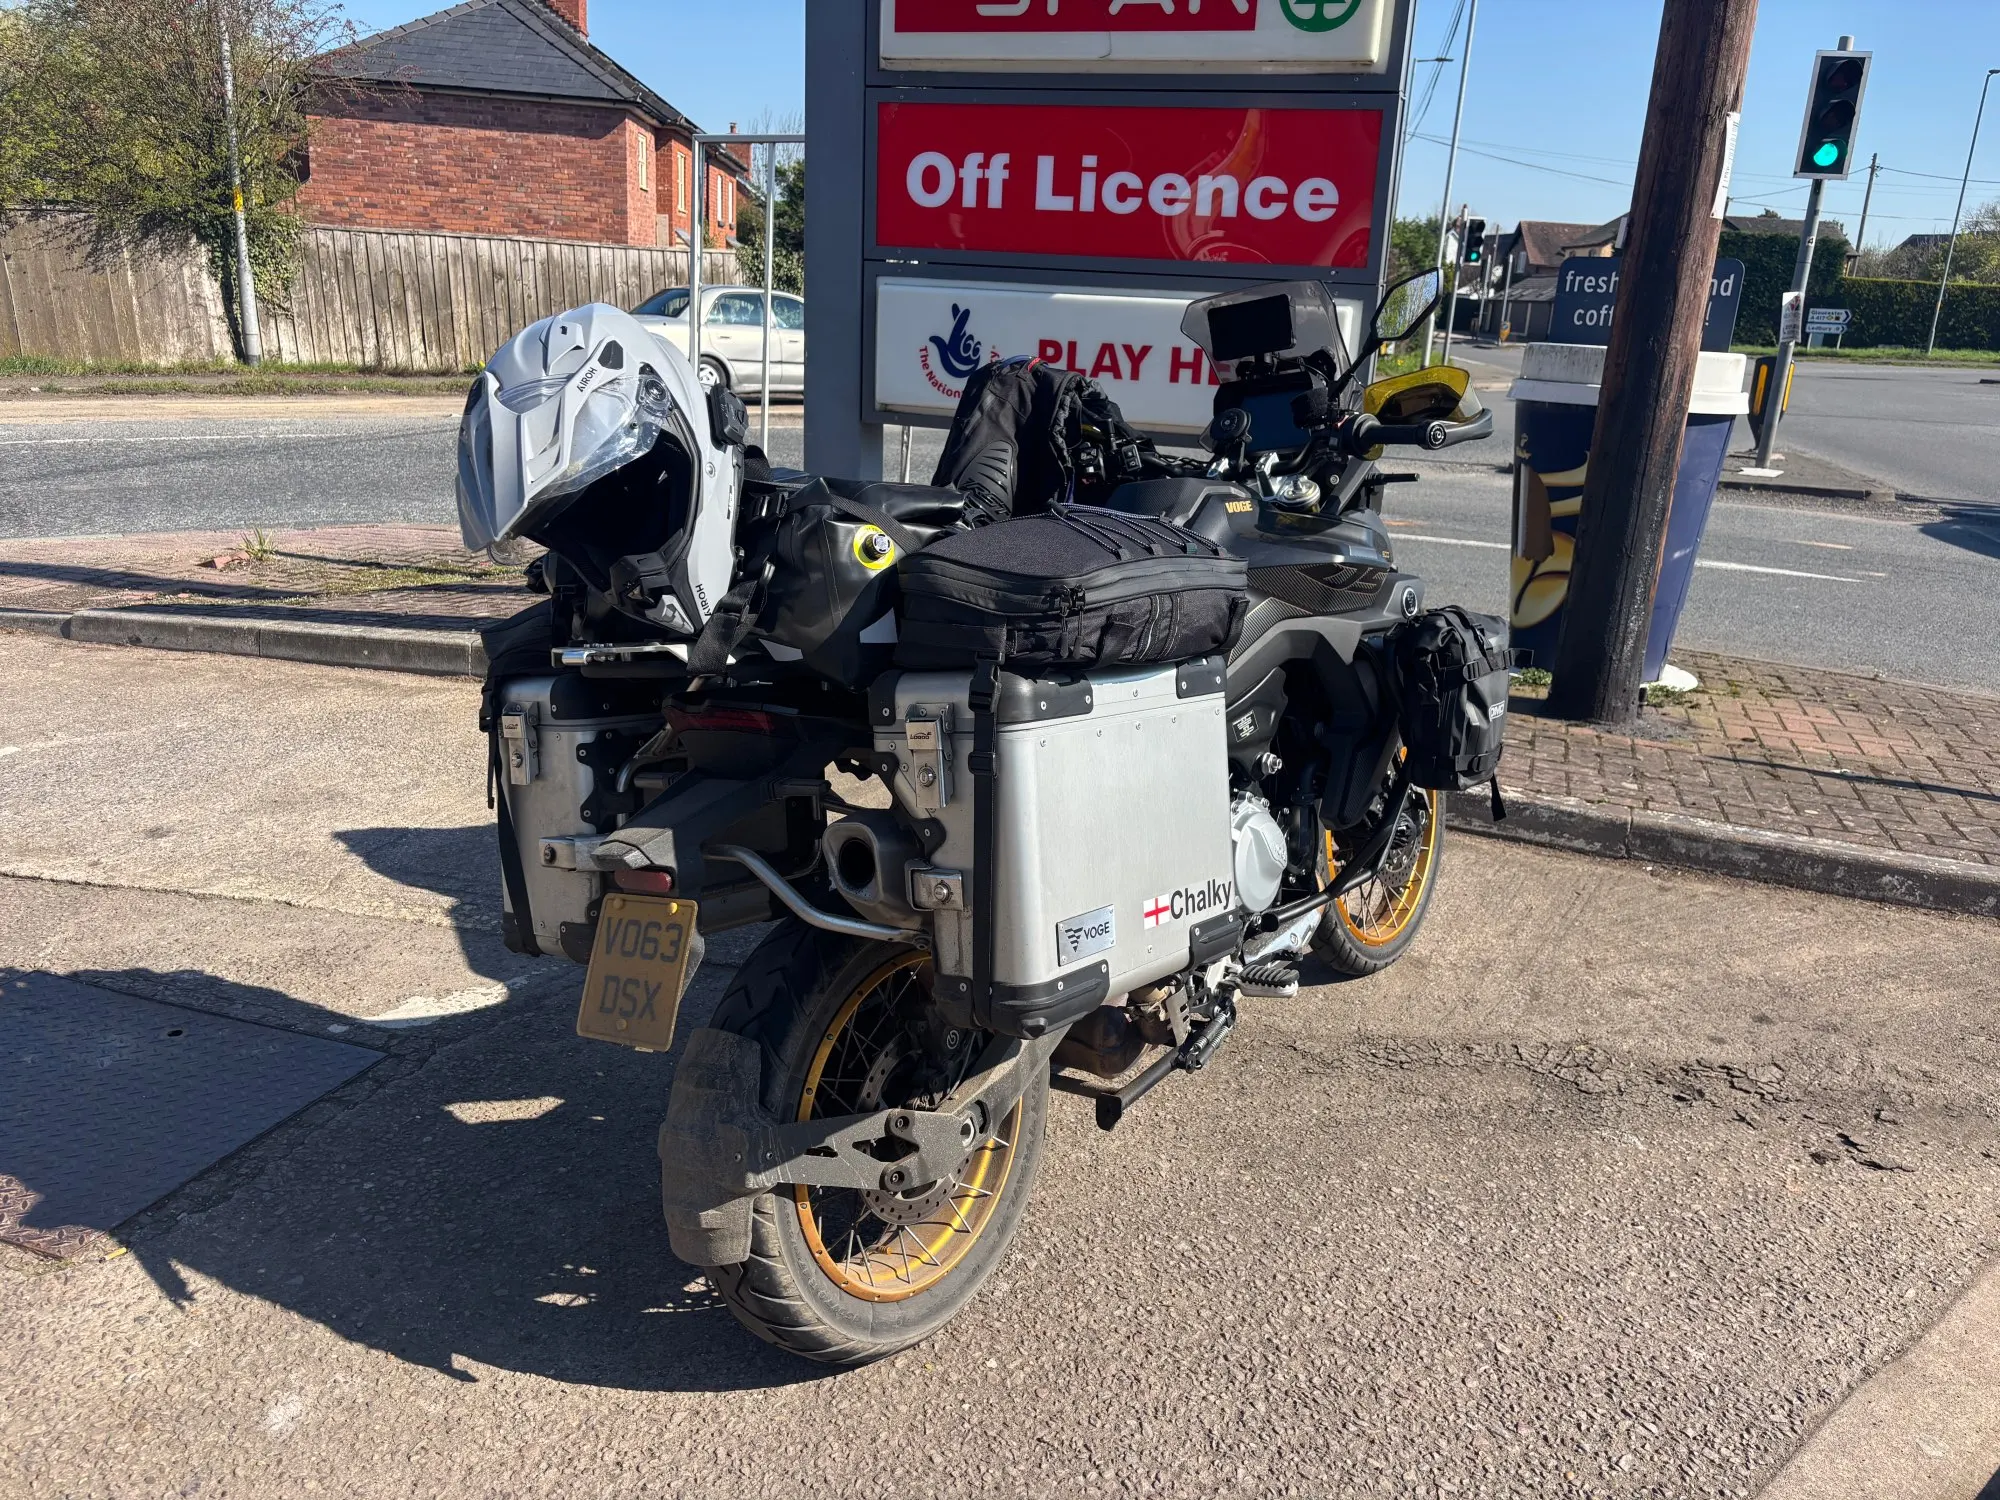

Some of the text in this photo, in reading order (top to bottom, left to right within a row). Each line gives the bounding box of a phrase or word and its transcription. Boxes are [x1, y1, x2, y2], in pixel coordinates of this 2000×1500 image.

[906, 151, 1339, 222] Off Licence
[576, 366, 598, 393] AIROH
[919, 345, 964, 399] The Nation
[1037, 338, 1153, 382] PLAY
[1225, 500, 1253, 513] VOGE
[1170, 878, 1233, 920] Chalky
[1084, 922, 1110, 940] VOGE
[598, 975, 663, 1021] DSX
